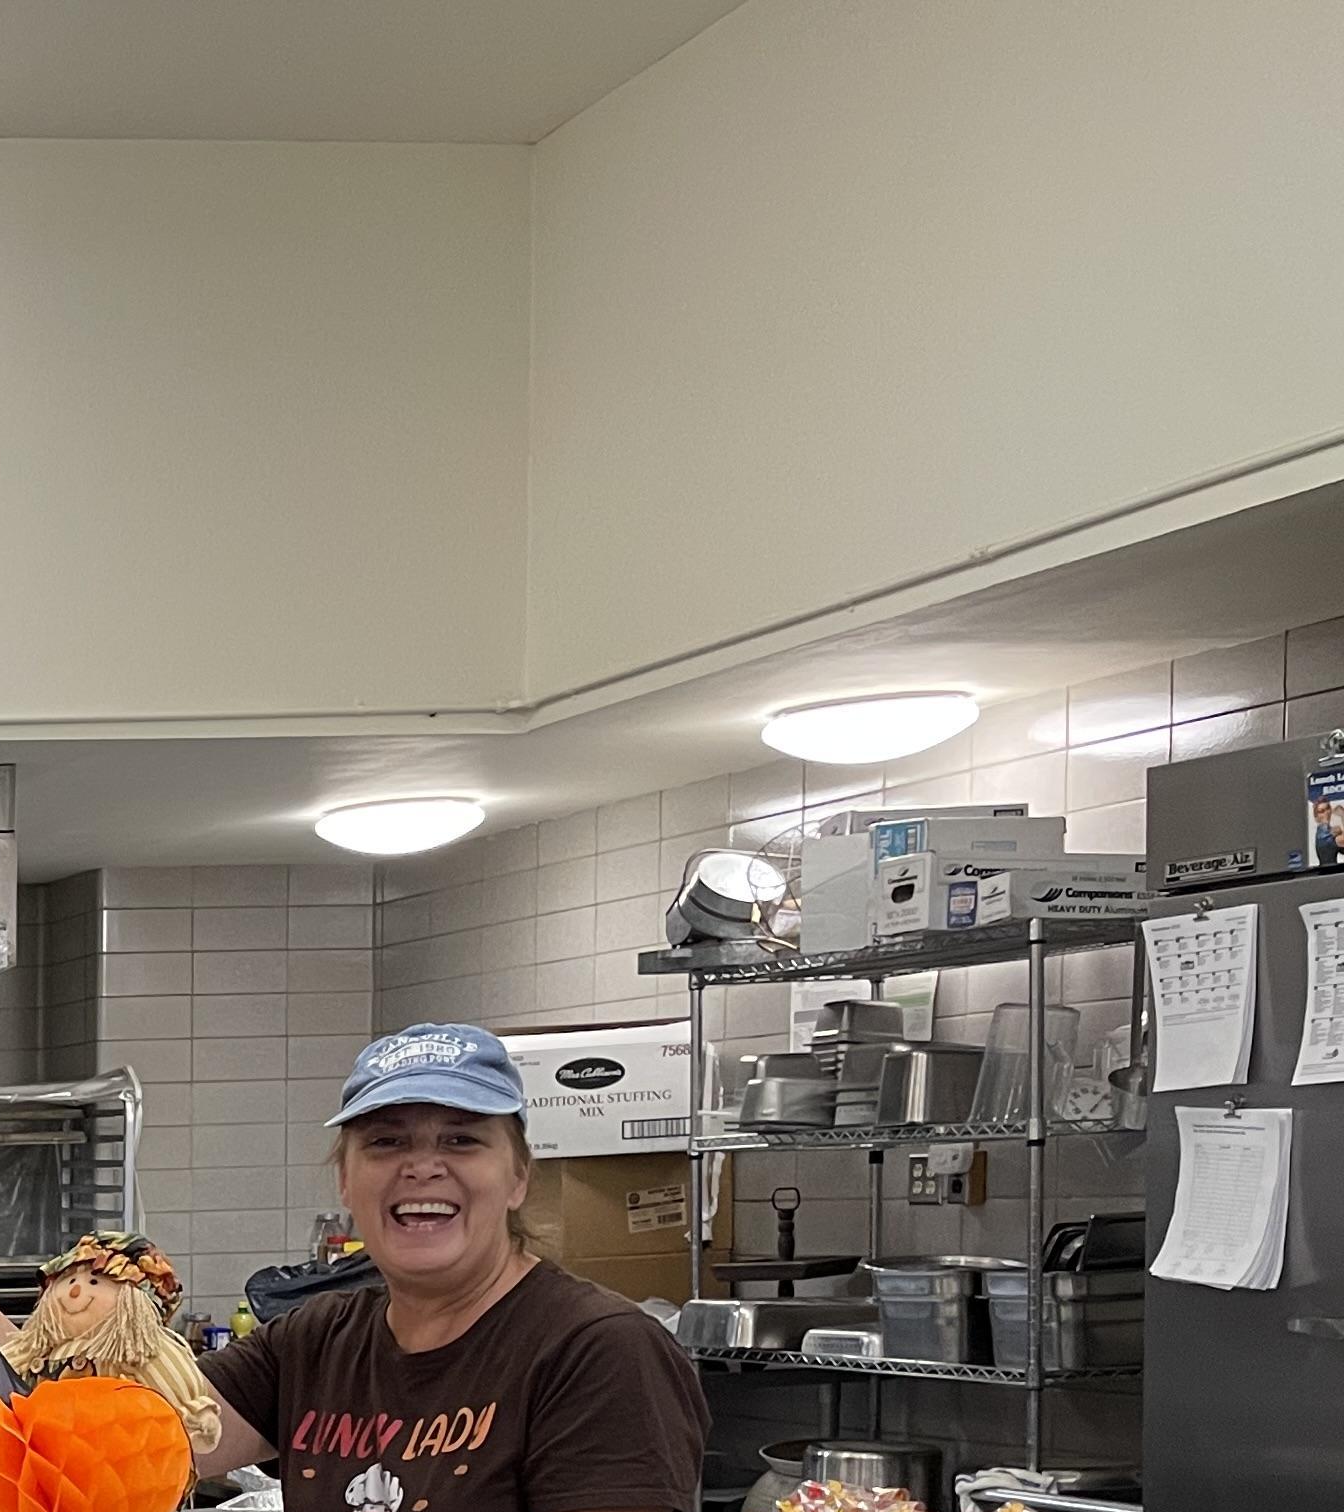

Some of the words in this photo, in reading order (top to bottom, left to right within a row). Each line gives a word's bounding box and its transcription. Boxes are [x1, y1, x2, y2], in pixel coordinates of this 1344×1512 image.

[1047, 905, 1076, 914] HEAVY
[1079, 905, 1102, 914] DUTY
[525, 1094, 603, 1108] ADITIONAL
[607, 1089, 672, 1104] STUFFING
[579, 1106, 605, 1117] MIX
